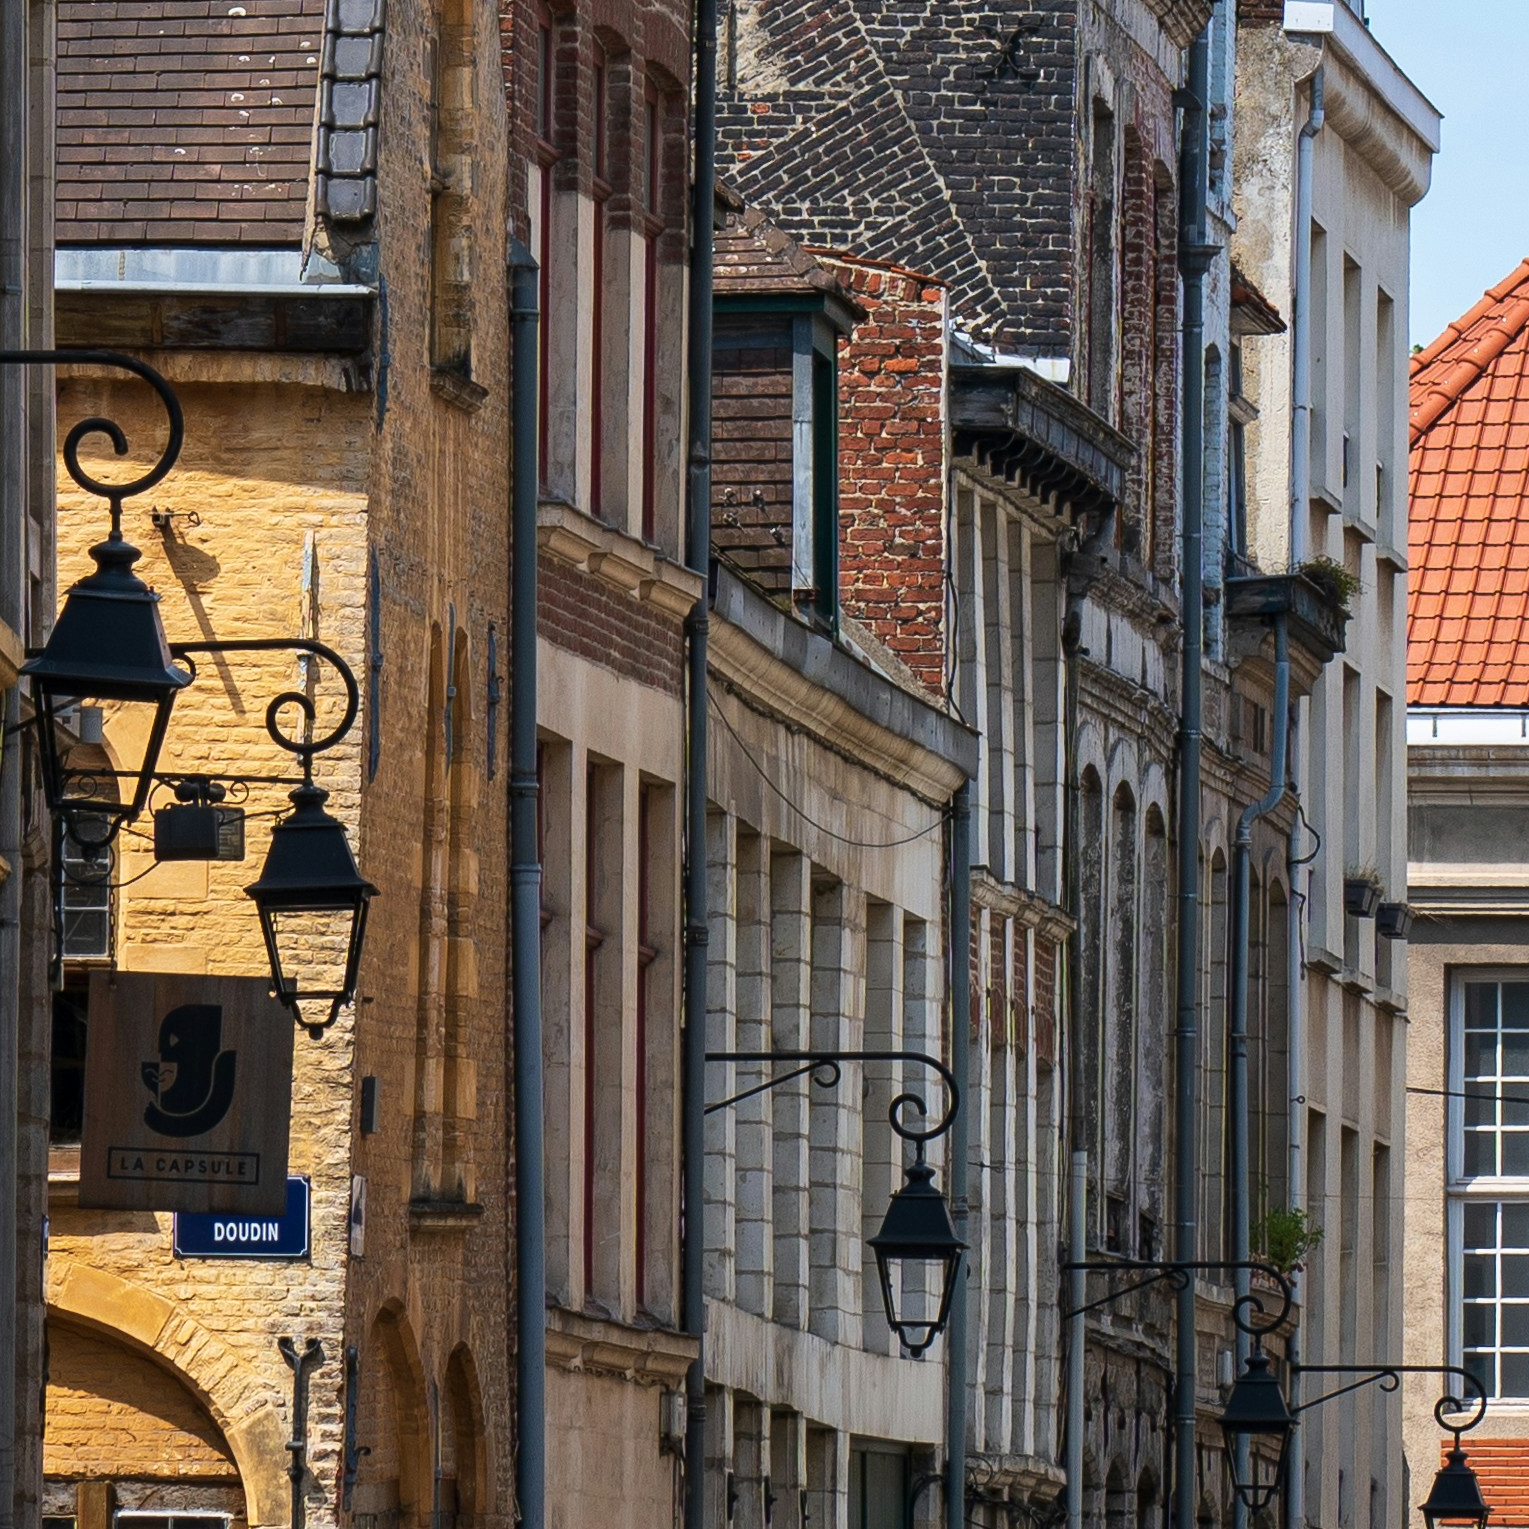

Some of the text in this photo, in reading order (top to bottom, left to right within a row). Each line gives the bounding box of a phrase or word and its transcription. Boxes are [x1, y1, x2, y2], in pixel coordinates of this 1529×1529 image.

[120, 1156, 247, 1175] LA CAPSULE
[213, 1222, 279, 1242] DOUDIN
